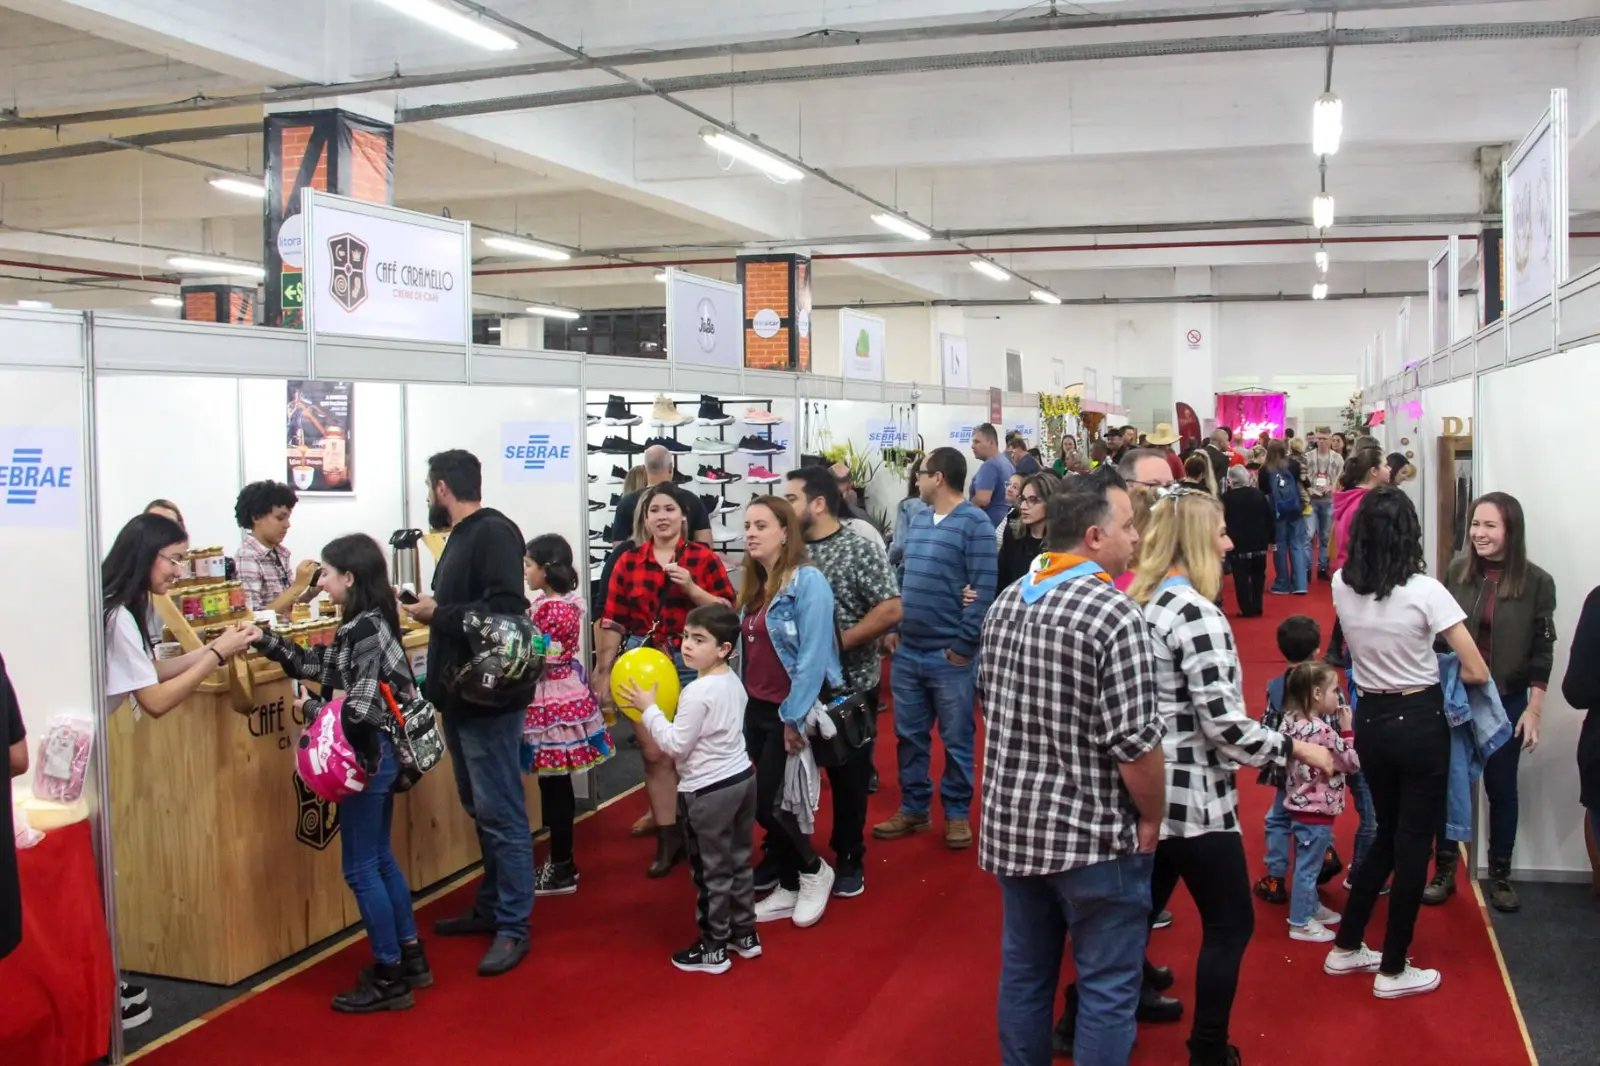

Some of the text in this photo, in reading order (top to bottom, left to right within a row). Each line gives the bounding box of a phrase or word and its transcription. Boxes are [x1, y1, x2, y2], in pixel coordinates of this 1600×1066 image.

[375, 260, 454, 291] CAFÉ CARAMELLO
[868, 432, 908, 441] SEBRAE
[505, 445, 570, 459] SEBRAE
[248, 697, 285, 737] CAFÉ
